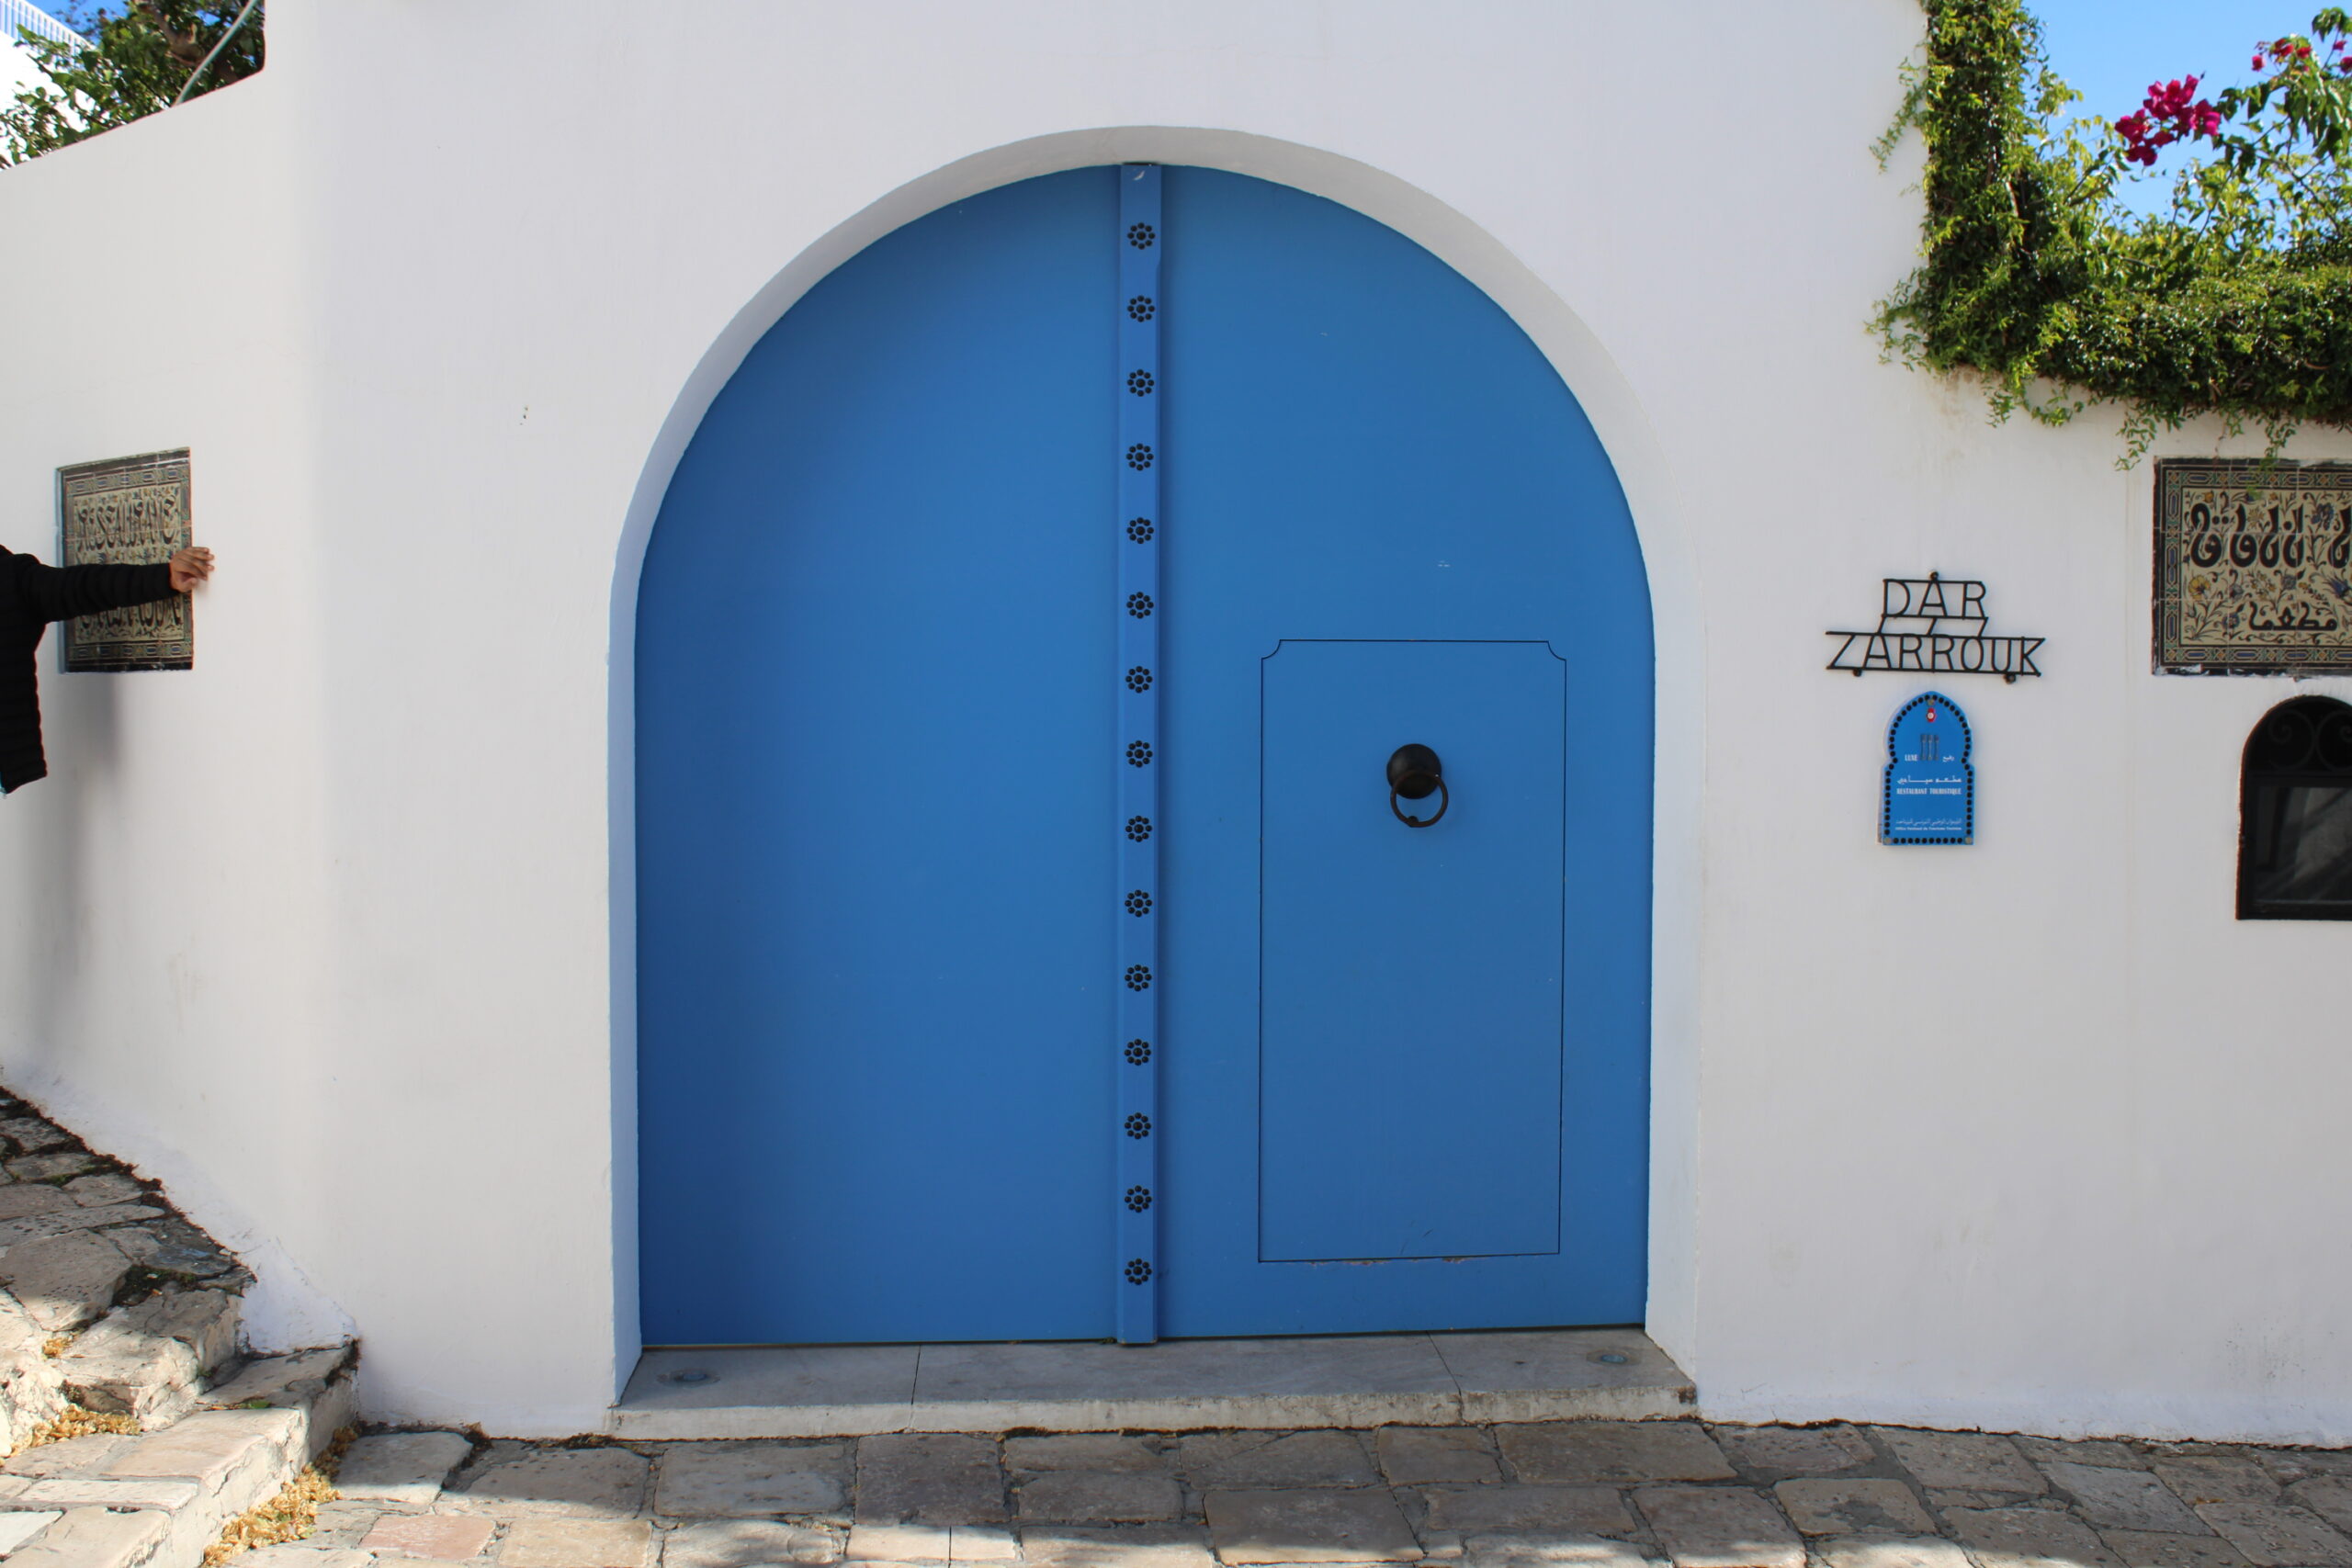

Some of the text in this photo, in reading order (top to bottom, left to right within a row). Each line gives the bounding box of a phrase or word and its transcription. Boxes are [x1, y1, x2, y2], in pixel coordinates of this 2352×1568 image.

[1882, 578, 1987, 619] DAR
[2248, 600, 2338, 631] مطعم
[1826, 630, 2046, 677] ZARROUK
